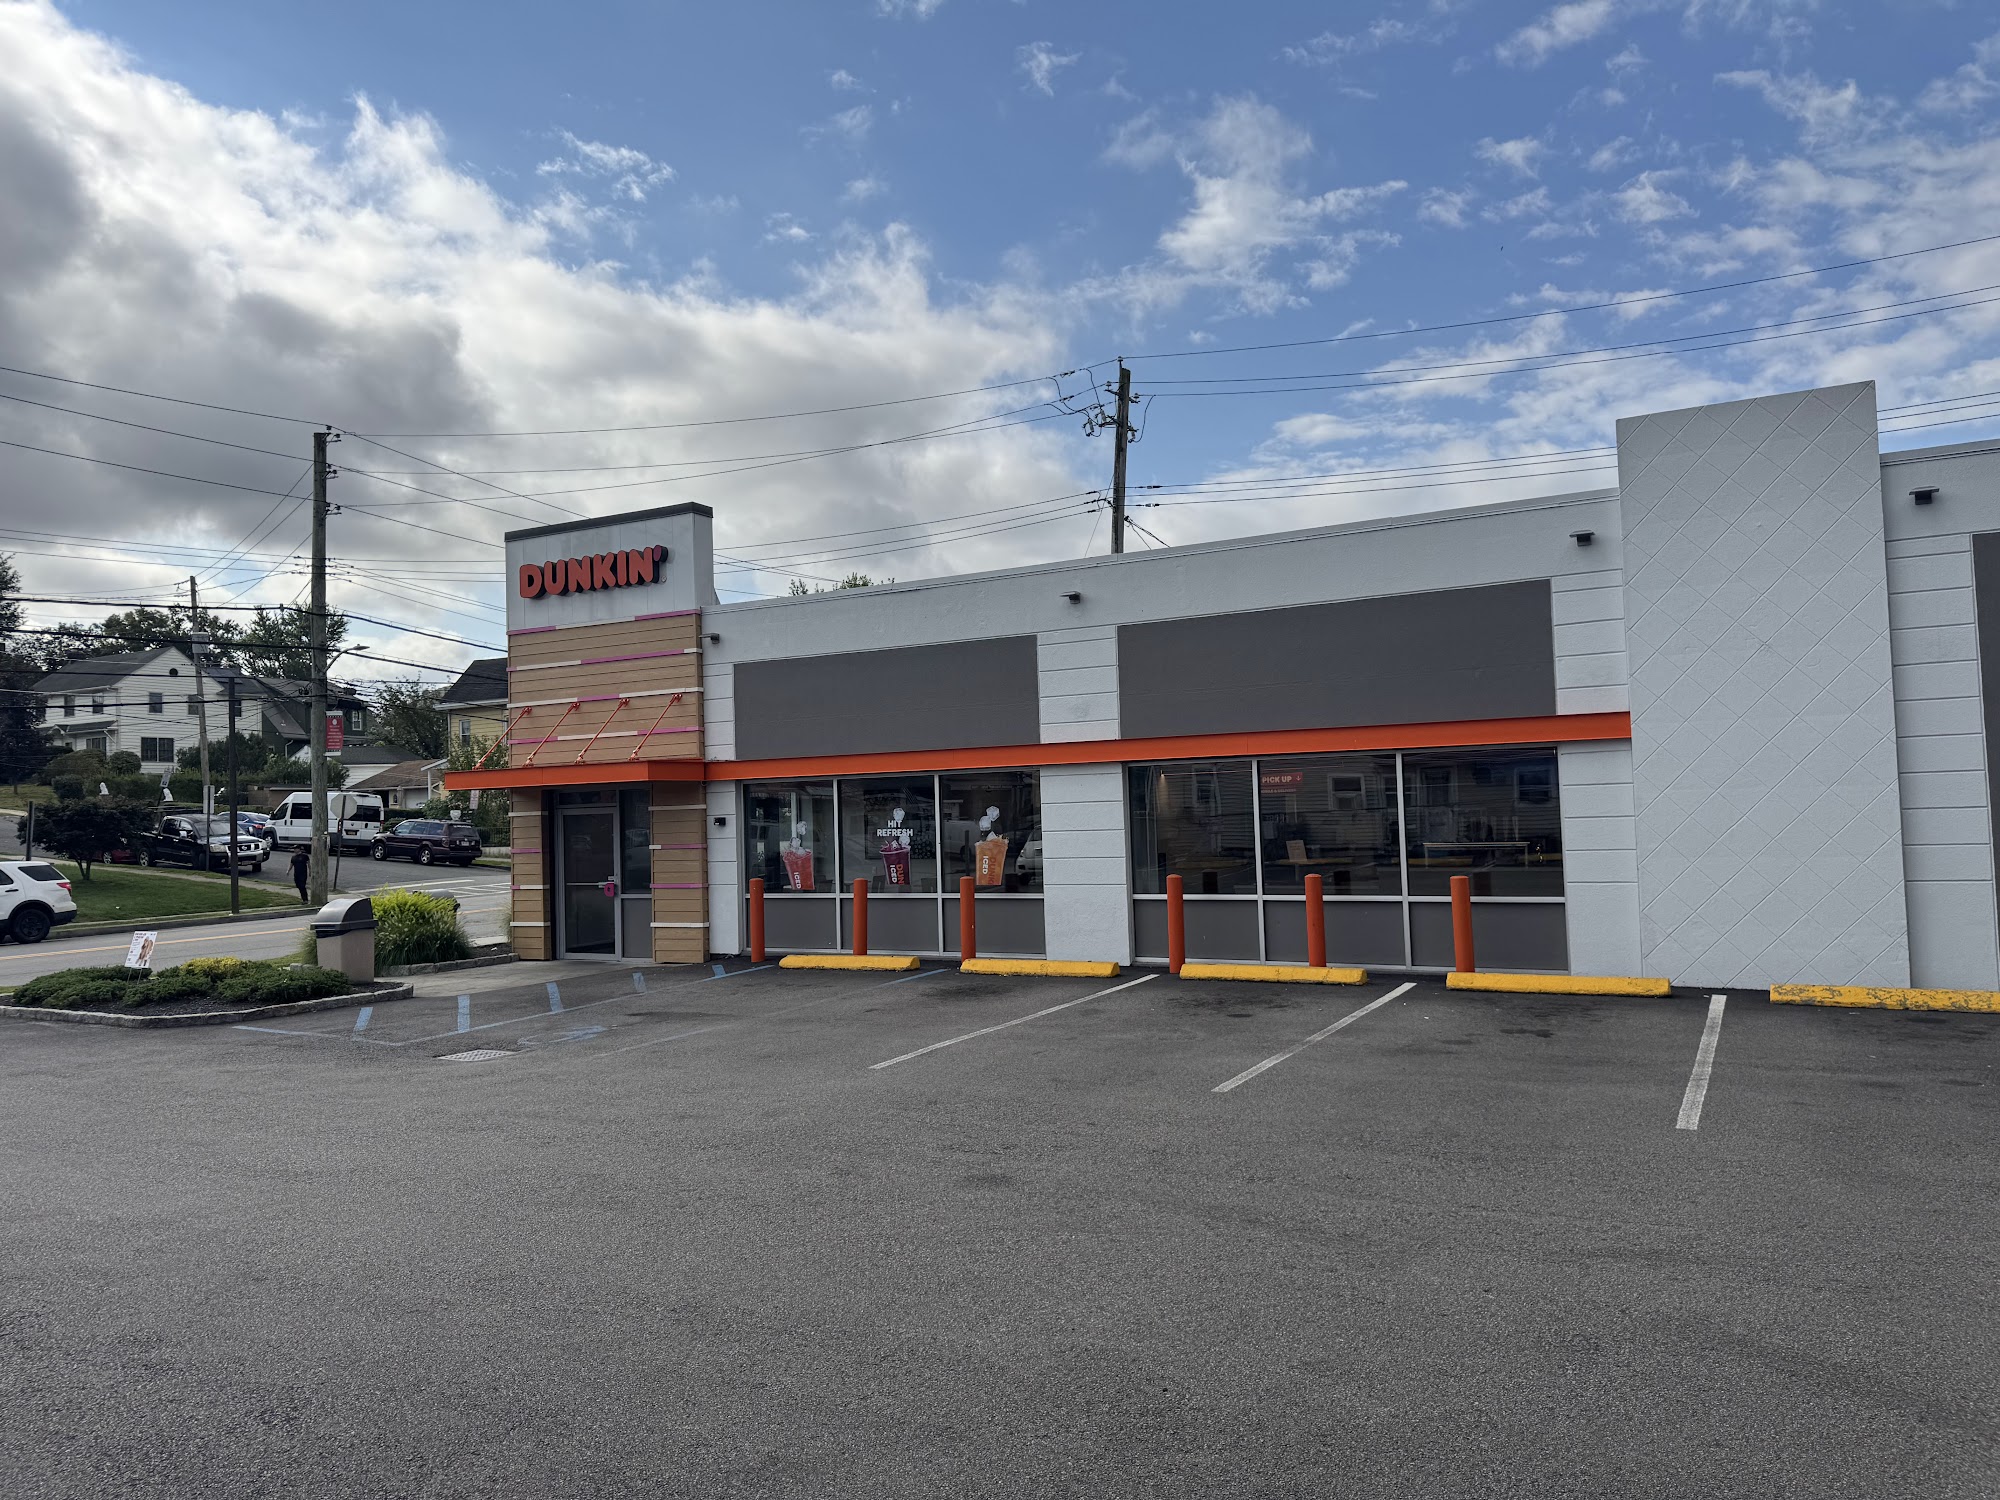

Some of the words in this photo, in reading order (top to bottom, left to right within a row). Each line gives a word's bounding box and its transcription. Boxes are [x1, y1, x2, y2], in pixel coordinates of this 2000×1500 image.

[519, 545, 666, 599] DUNKIN'
[877, 828, 913, 837] REFRESH
[887, 820, 902, 828] HIT
[793, 871, 802, 889] ICED
[890, 864, 898, 883] ICED
